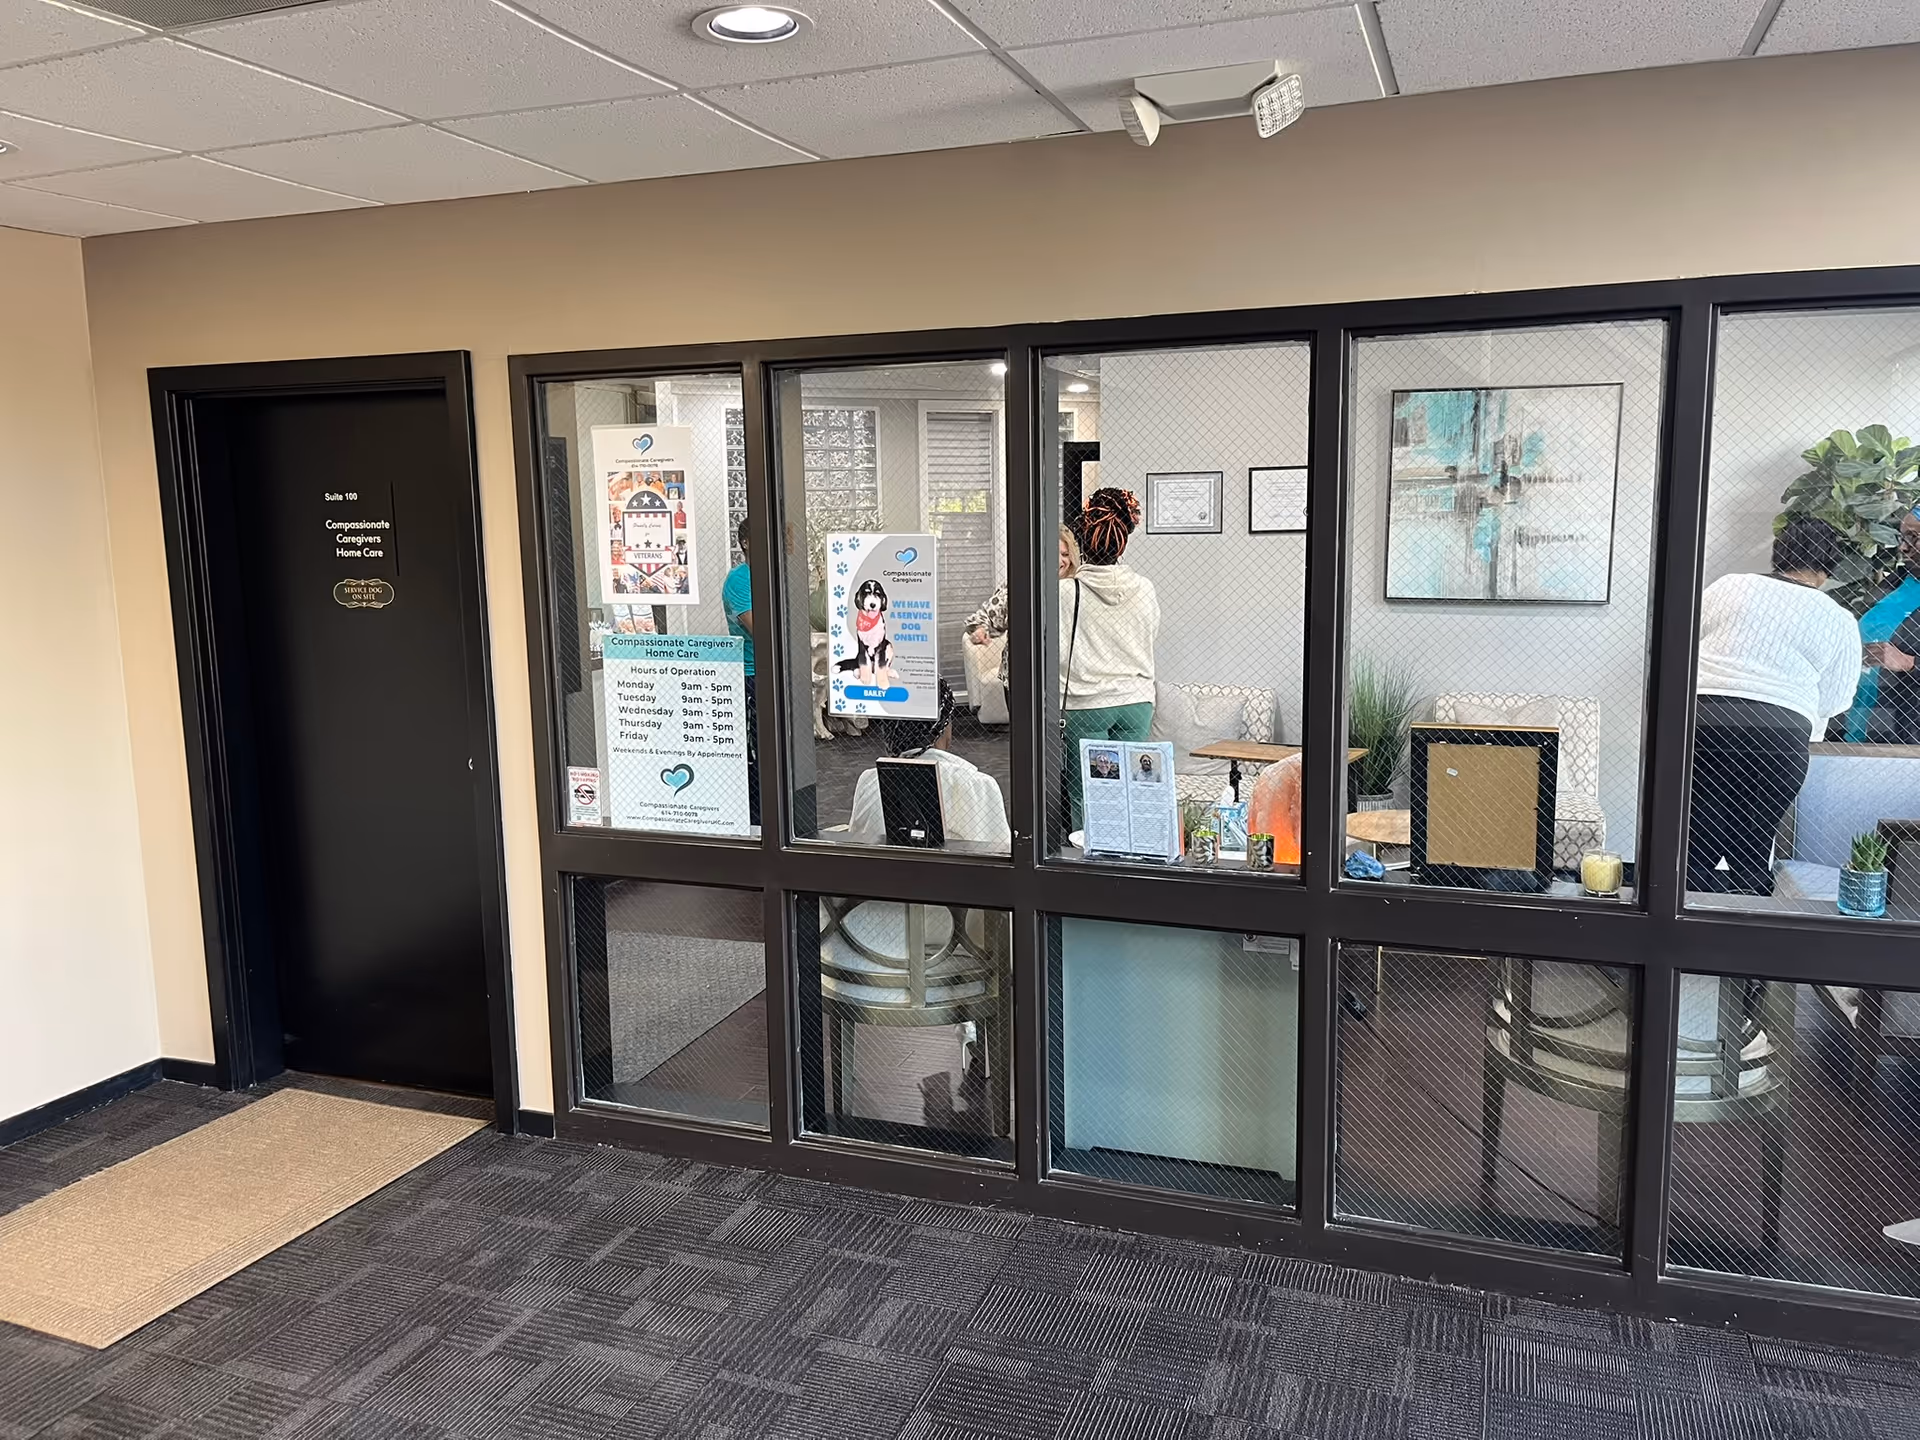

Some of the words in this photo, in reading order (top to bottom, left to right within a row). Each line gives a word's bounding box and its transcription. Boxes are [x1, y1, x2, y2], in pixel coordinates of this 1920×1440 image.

[325, 493, 343, 501] Suite
[325, 520, 390, 532] Compassionate
[336, 534, 381, 546] Caregivers
[336, 548, 362, 557] Home
[363, 548, 384, 557] Care
[907, 601, 931, 609] HAVE
[897, 612, 933, 620] SERVICE
[611, 638, 685, 648] Compassionate
[688, 639, 734, 649] Caregivers
[894, 634, 928, 642] ONSITE!
[646, 649, 674, 657] Home
[677, 649, 699, 658] Care
[630, 666, 657, 674] Hours
[660, 667, 668, 675] of
[670, 667, 716, 676] Operation
[617, 680, 655, 691] Monday
[681, 682, 702, 690] 9am
[710, 683, 732, 693] 5pm
[618, 693, 656, 703] Tuesday
[682, 695, 702, 704] 9am
[711, 696, 733, 706] 5pm
[618, 706, 674, 717] Wednesday
[682, 708, 703, 717] 9am
[712, 709, 733, 719] 5pm
[619, 718, 662, 729] Thursday
[682, 721, 704, 730] 9am
[712, 722, 734, 732] 5pm
[620, 731, 649, 742] Friday
[683, 734, 704, 742] 9am
[713, 736, 734, 745] 5pm
[612, 746, 648, 754] Weekends
[697, 751, 742, 759] Appointment
[690, 804, 720, 812] Caregivers
